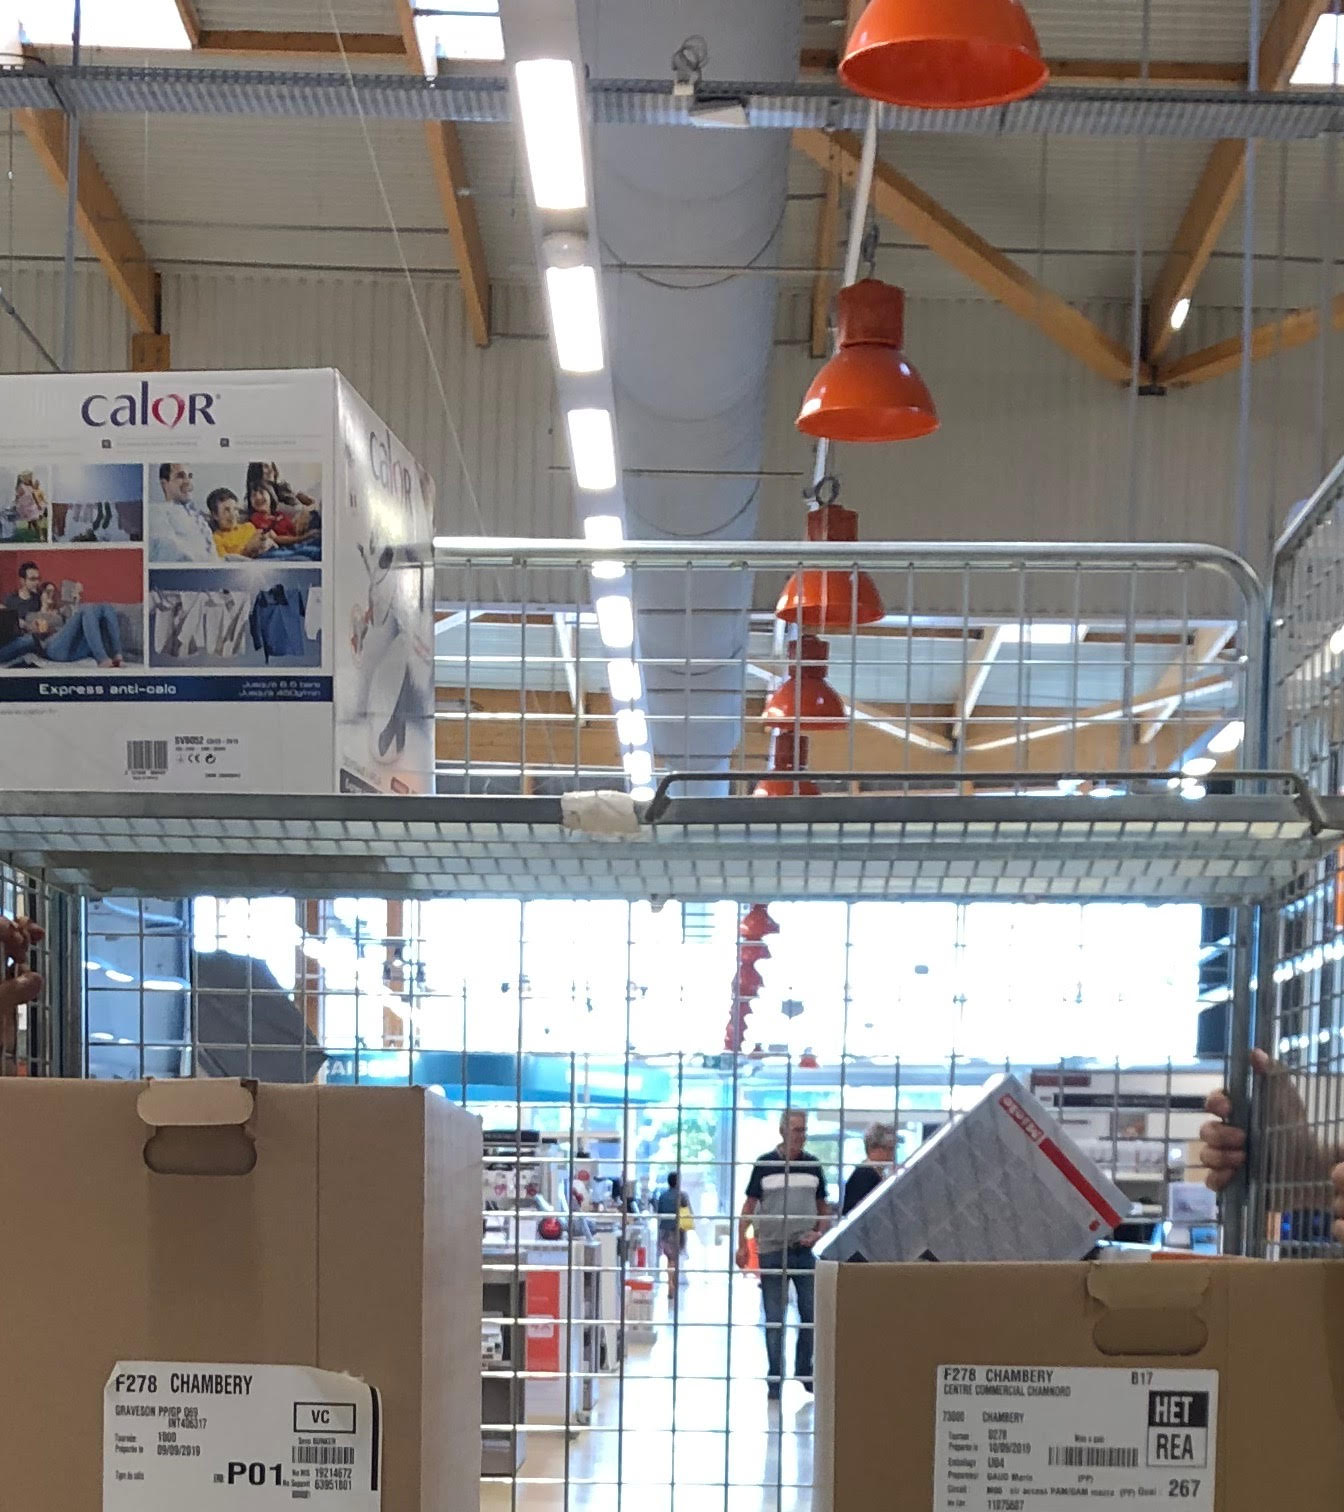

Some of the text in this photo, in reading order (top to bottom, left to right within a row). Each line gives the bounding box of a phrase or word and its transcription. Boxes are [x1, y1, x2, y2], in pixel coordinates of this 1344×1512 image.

[38, 683, 177, 697] Express anti-calc
[114, 1373, 253, 1395] F278 CHAMBERY
[943, 1367, 976, 1381] F278
[985, 1368, 1054, 1384] CHAMBERY
[943, 1383, 972, 1395] CENTRE
[975, 1384, 1025, 1397] COMMERCIAL
[311, 1409, 330, 1424] VC
[982, 1410, 1024, 1423] CHAMBERY
[1155, 1395, 1194, 1423] HET
[1156, 1433, 1194, 1460] REA
[227, 1461, 282, 1486] P01
[1168, 1478, 1201, 1498] 267
